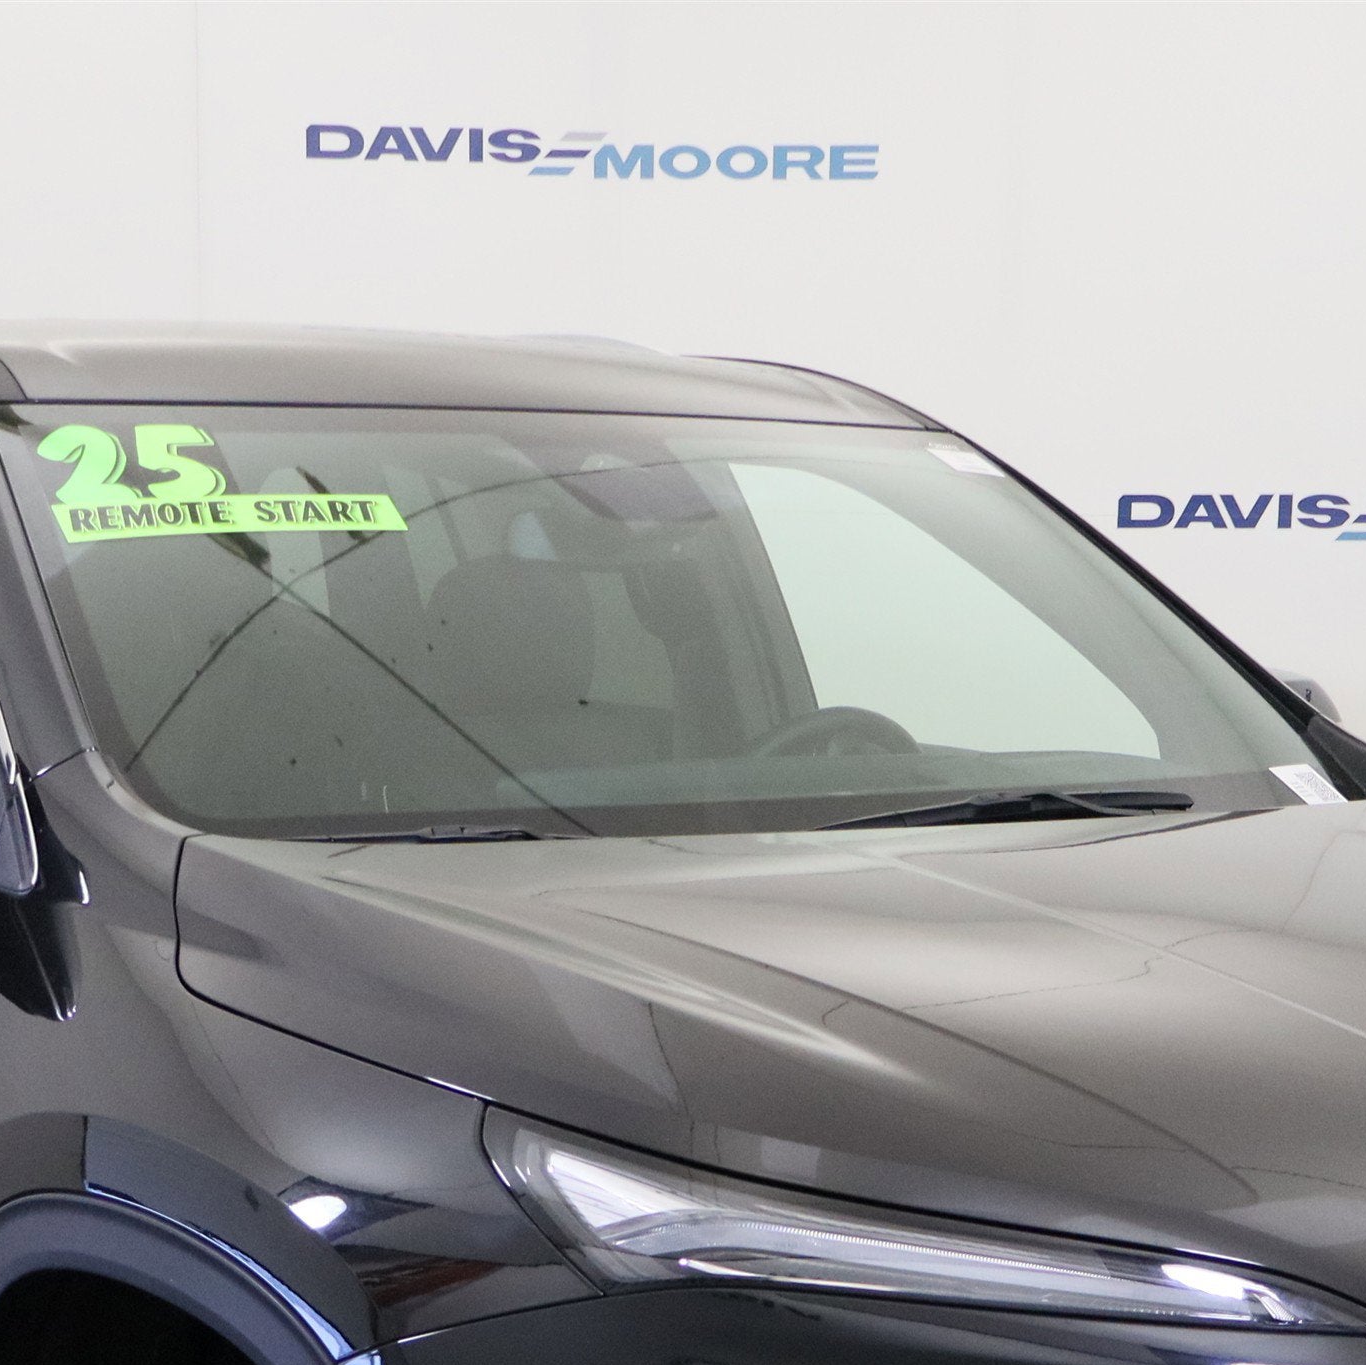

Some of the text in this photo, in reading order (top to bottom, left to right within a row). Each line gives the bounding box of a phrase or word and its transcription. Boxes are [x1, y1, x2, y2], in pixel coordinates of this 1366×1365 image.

[305, 123, 879, 180] DAVIS MOORE
[37, 424, 227, 504] 25
[68, 498, 379, 533] REMOTE START
[1116, 493, 1351, 530] DAVIS
